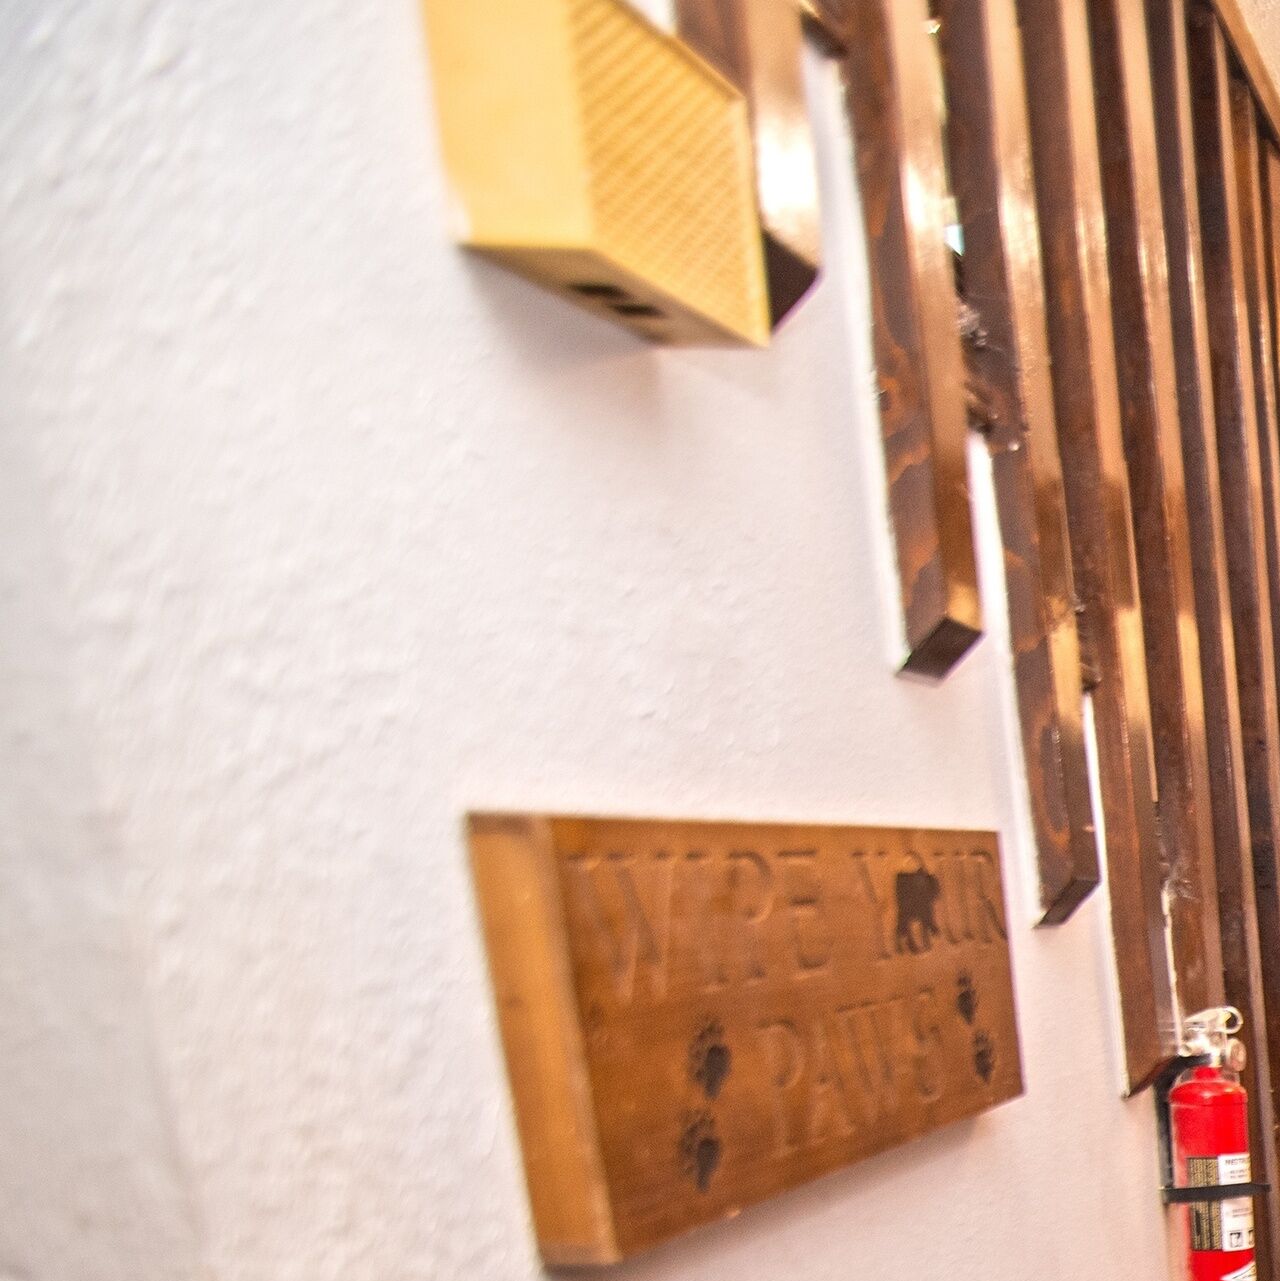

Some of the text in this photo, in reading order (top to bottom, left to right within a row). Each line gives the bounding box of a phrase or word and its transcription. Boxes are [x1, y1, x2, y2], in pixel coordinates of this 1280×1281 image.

[560, 848, 1009, 1002] WIPE YUR
[753, 983, 943, 1158] PAWS
